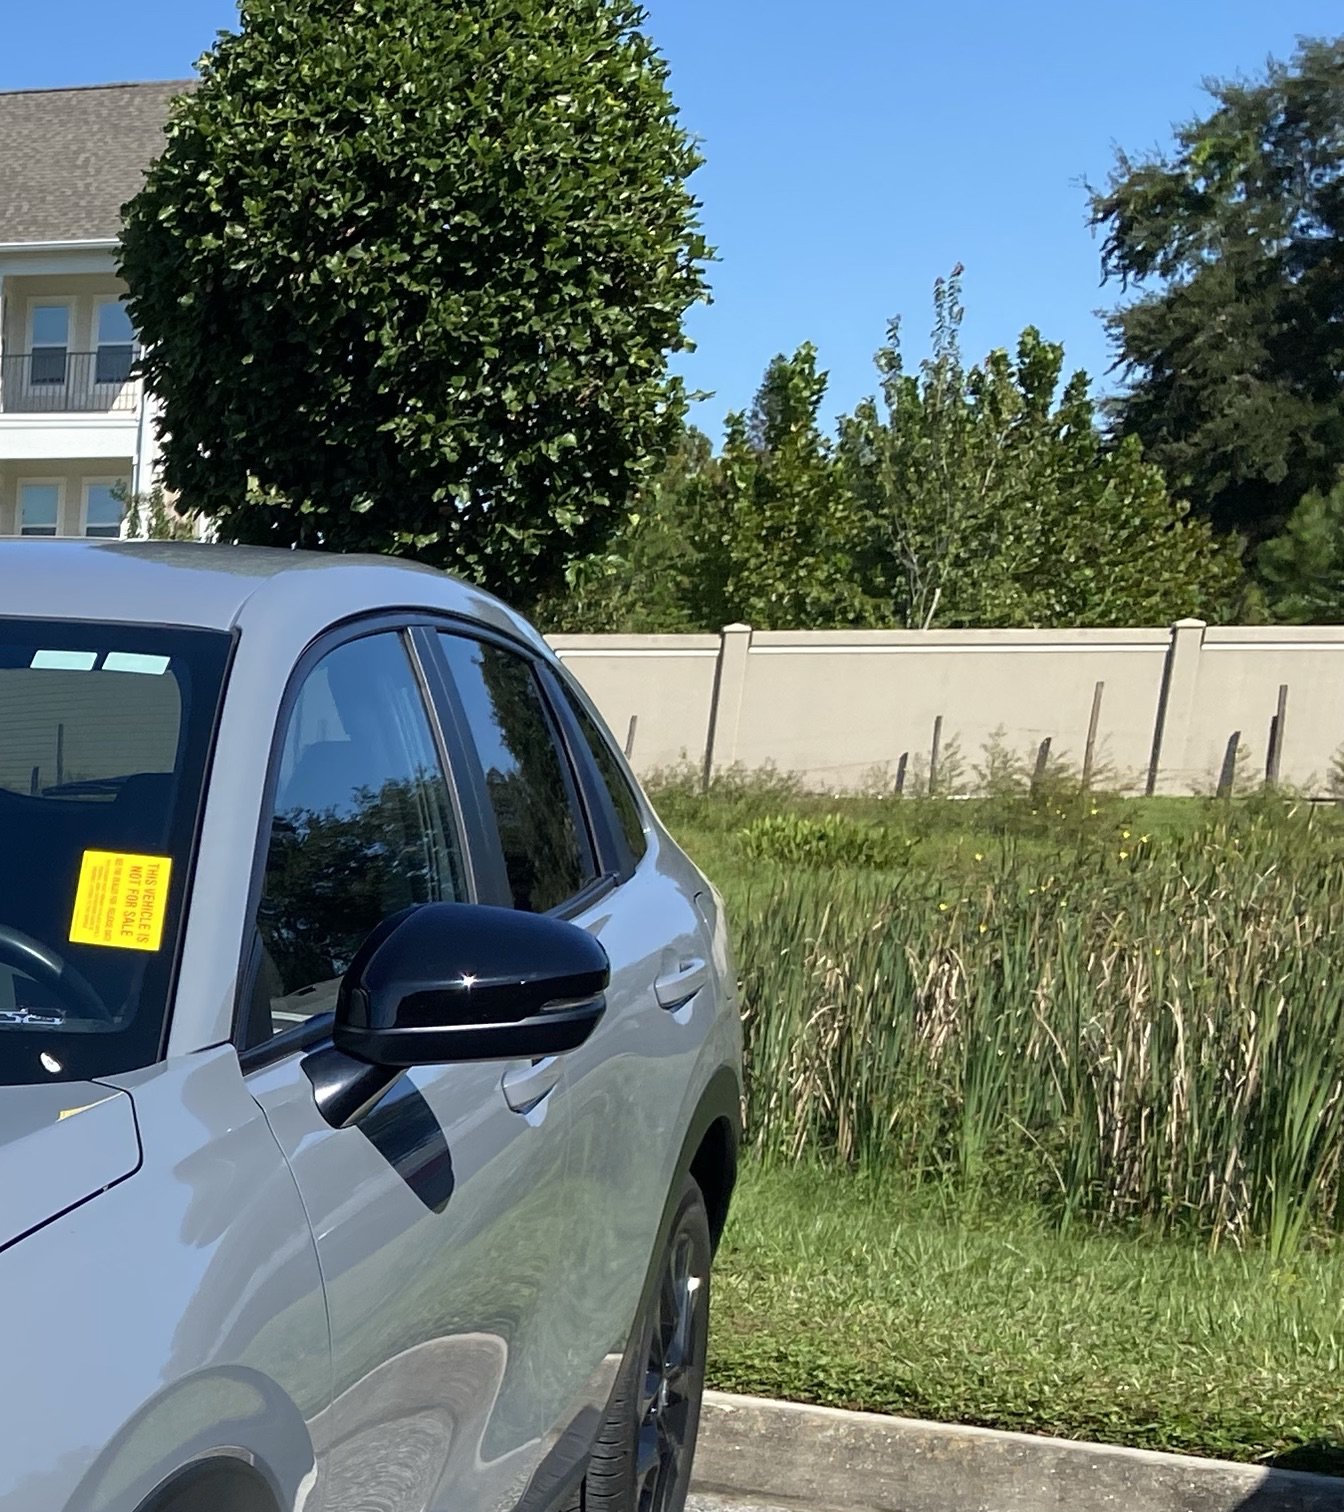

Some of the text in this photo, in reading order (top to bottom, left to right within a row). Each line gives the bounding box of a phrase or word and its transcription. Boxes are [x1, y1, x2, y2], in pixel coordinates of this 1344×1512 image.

[120, 865, 143, 937] NOT FOR SALE
[136, 864, 160, 943] THIS VEHICLE IS
